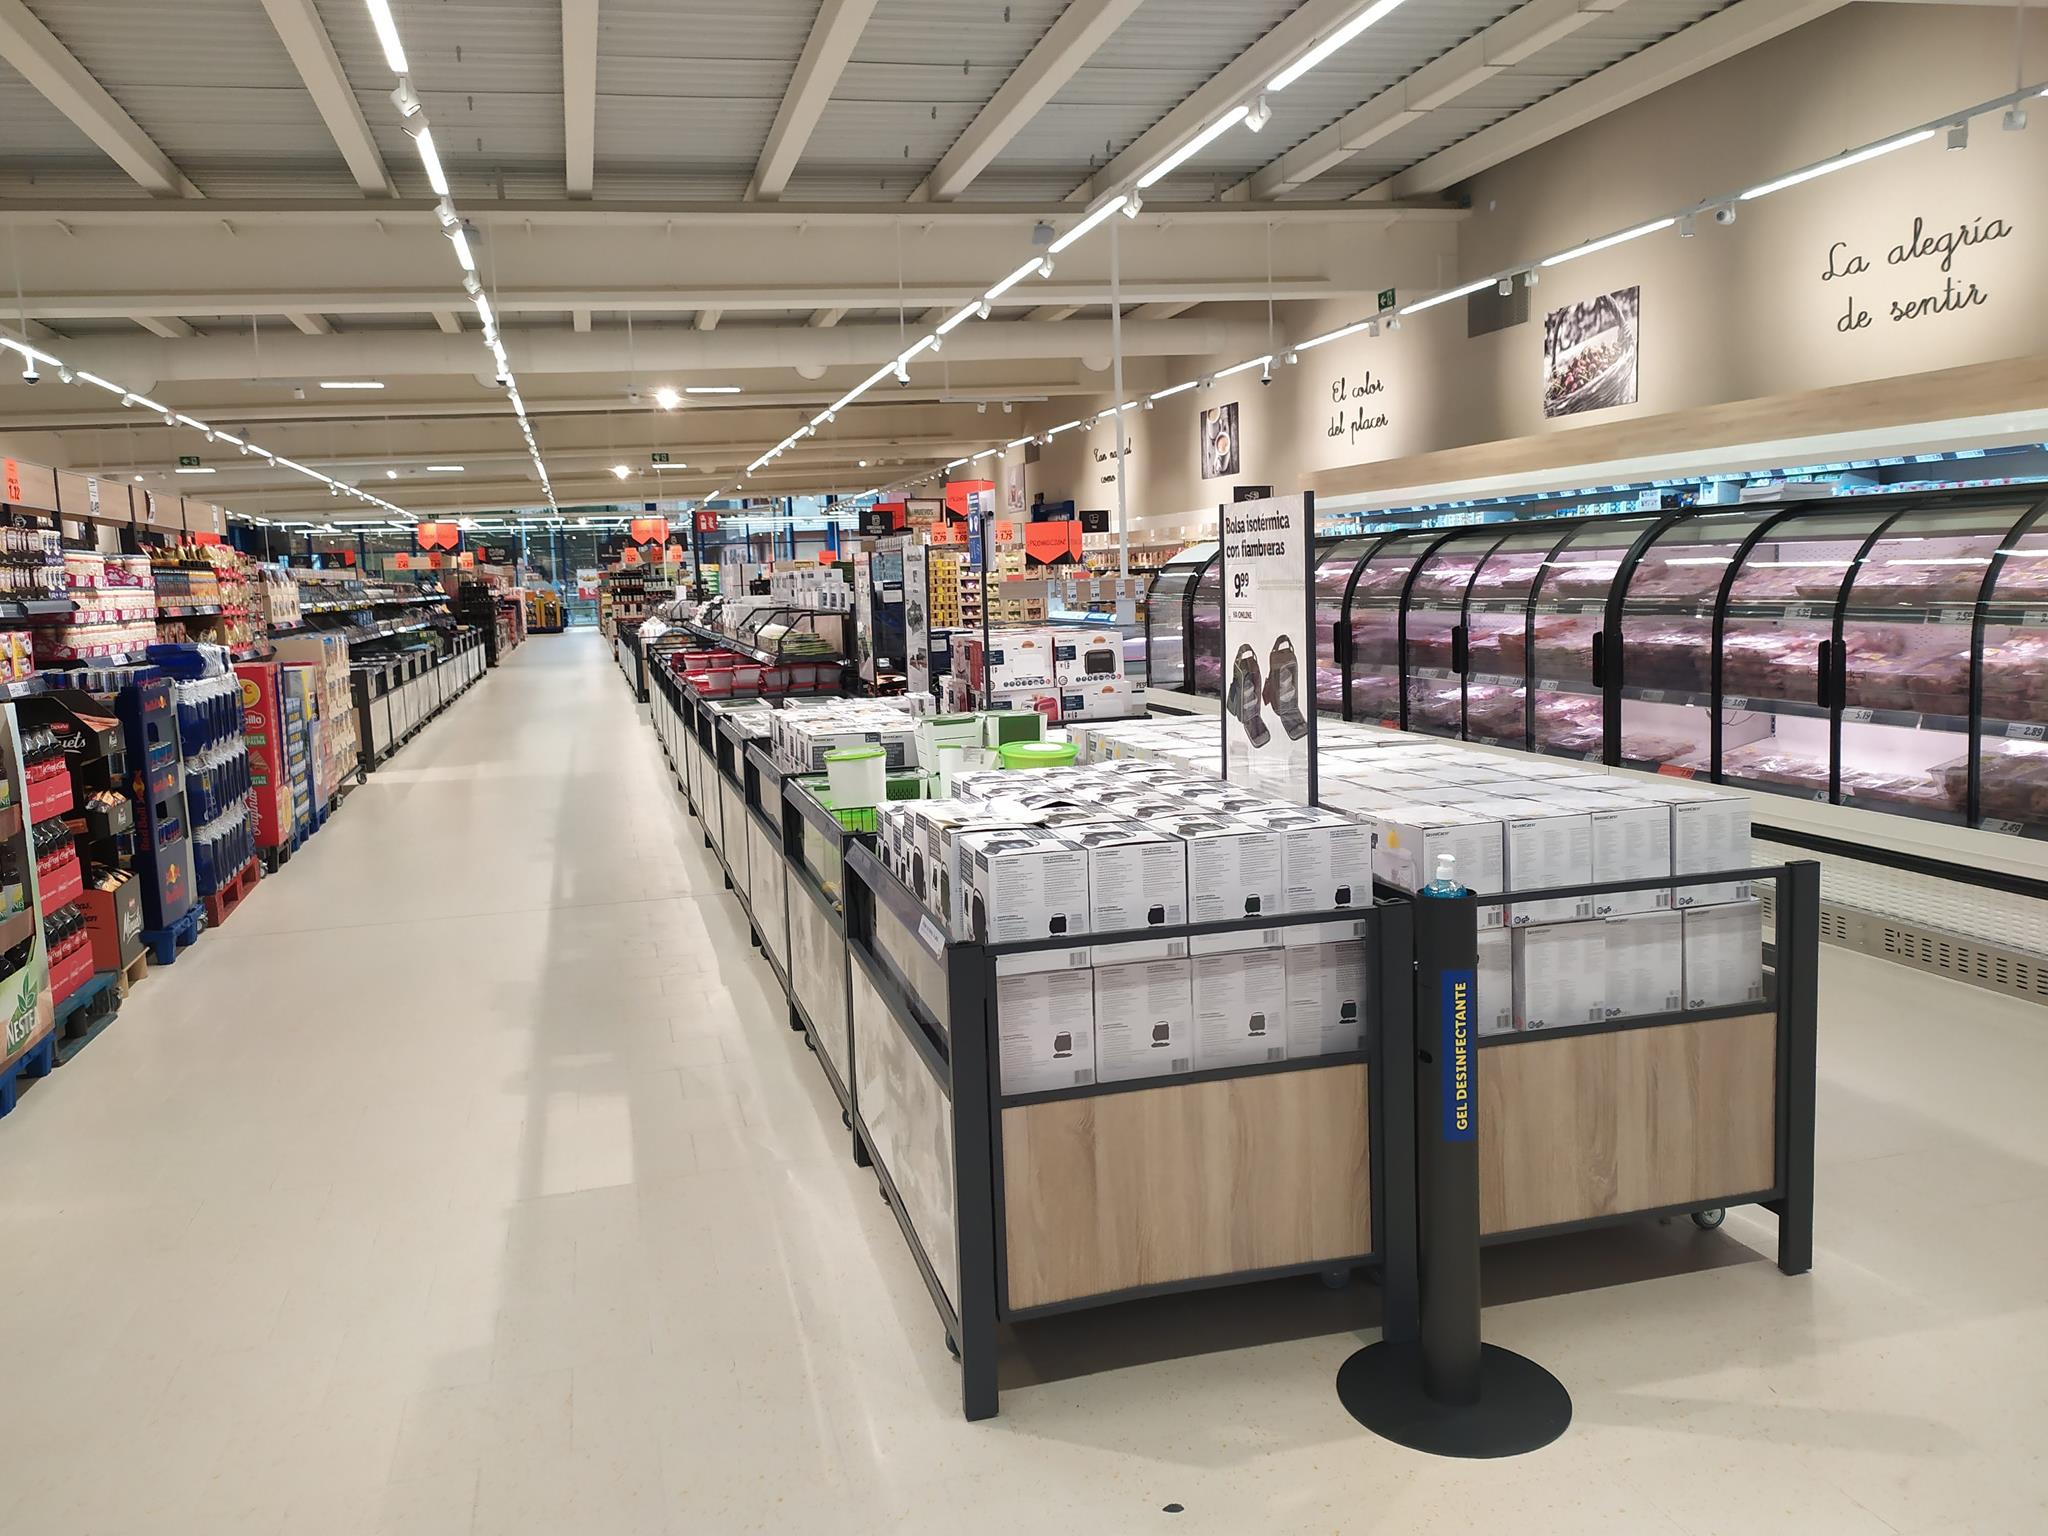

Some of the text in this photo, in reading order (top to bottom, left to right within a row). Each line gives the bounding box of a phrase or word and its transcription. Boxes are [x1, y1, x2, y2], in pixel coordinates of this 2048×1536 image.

[1821, 216, 2013, 282] La alegría
[1837, 276, 1988, 333] de sentir
[1332, 370, 1384, 403] El color
[1327, 406, 1389, 445] del placer
[1225, 510, 1291, 535] Bolsa isotérmica
[1226, 538, 1286, 559] con fiambreras
[1855, 710, 1871, 720] 5.19
[2023, 726, 2044, 737] 2.89
[2000, 822, 2021, 834] 2.49
[1455, 982, 1468, 1131] GEL DESINFECTANTE
